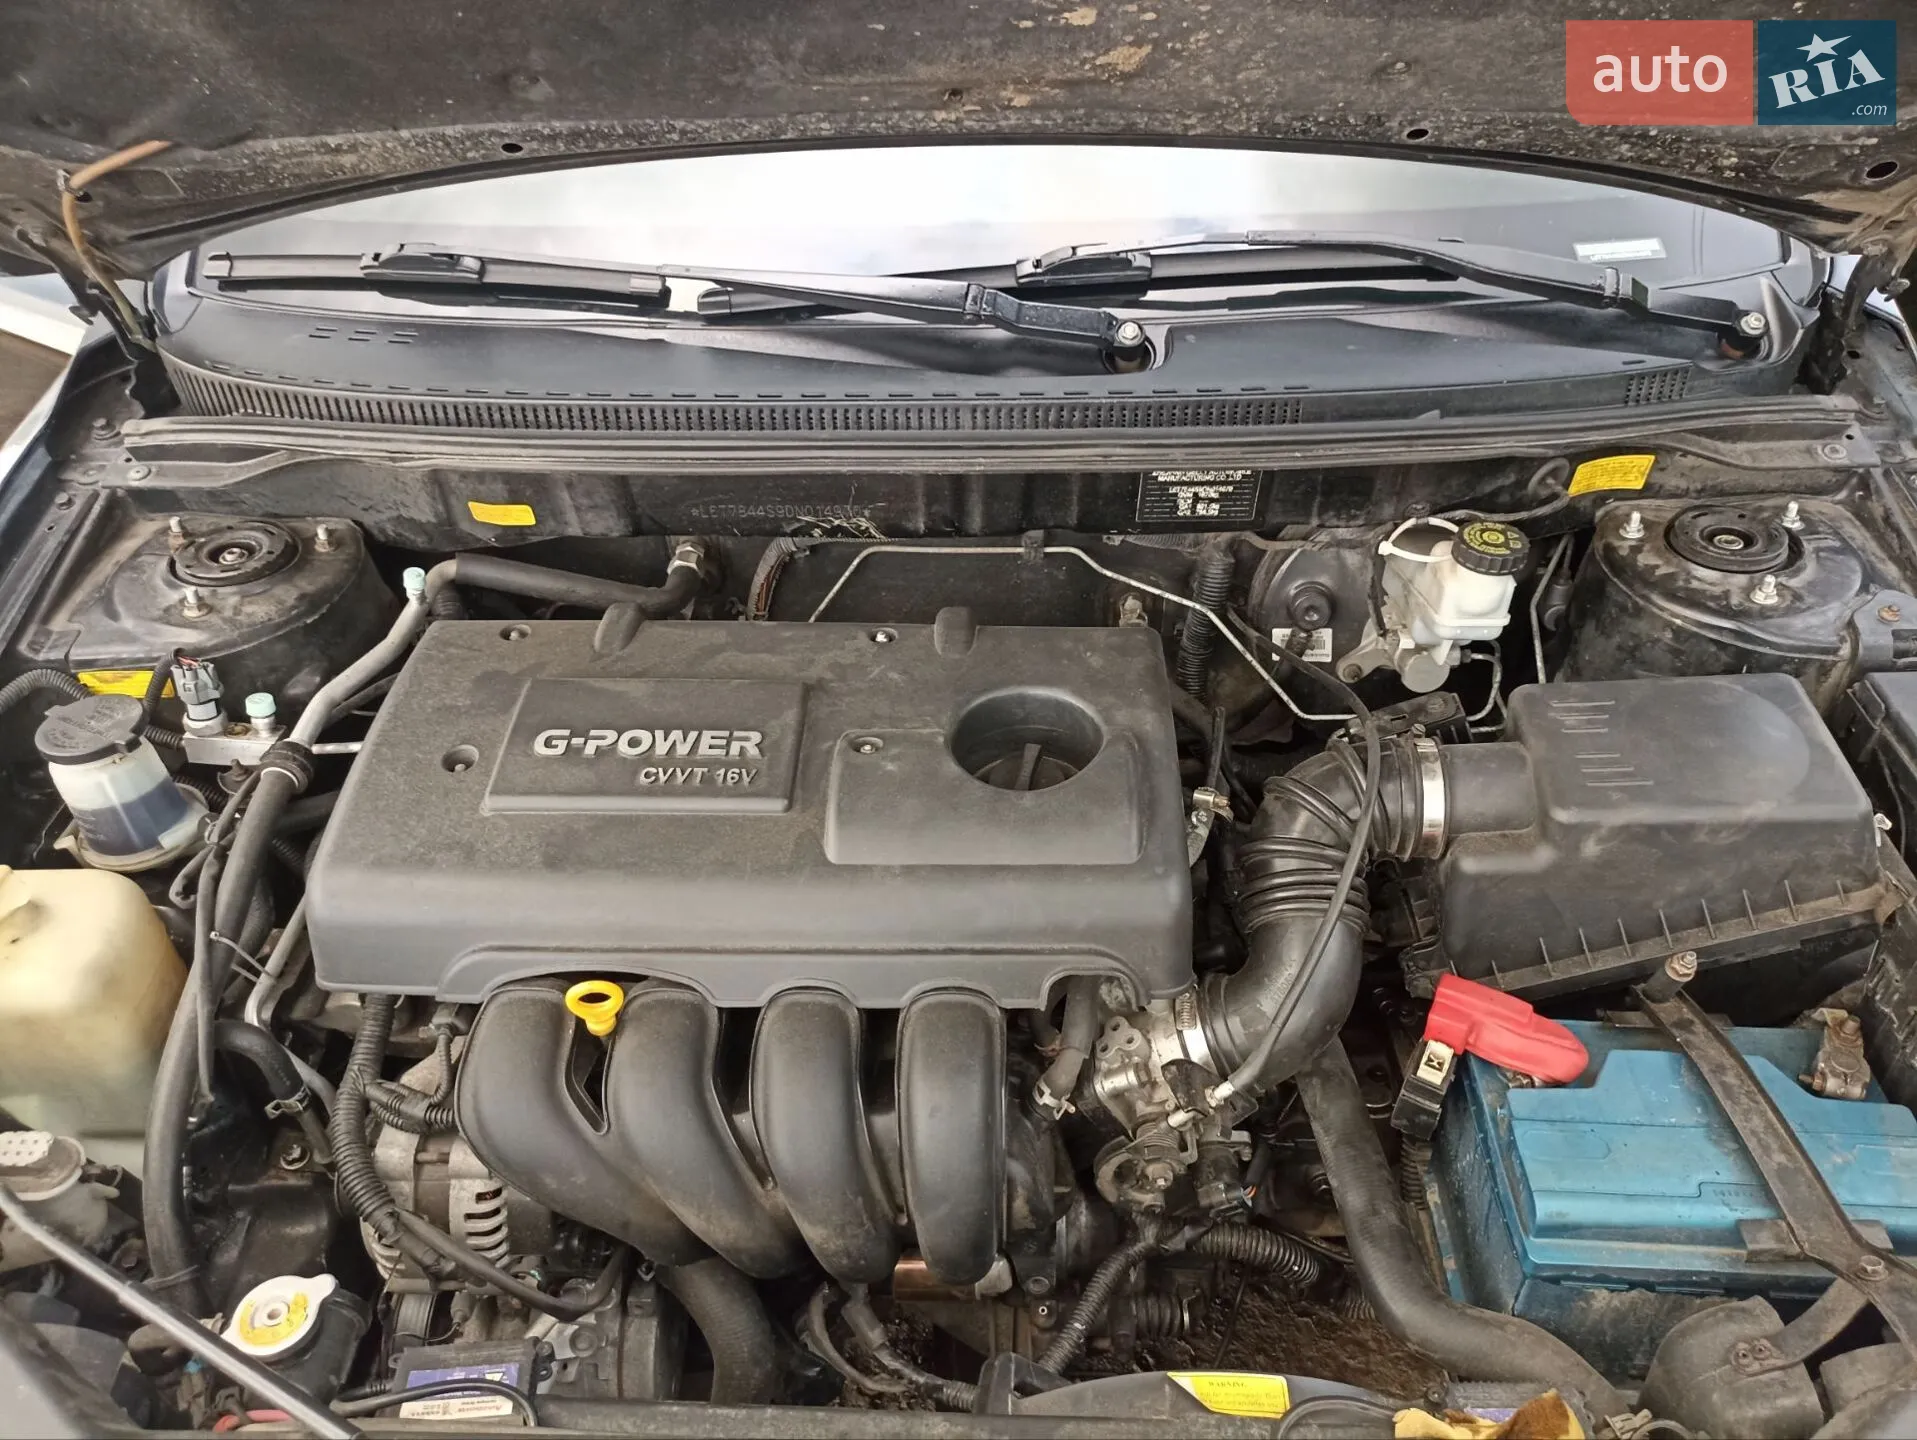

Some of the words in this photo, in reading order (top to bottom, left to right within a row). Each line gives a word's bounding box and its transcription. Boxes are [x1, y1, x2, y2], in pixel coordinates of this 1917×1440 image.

[534, 728, 763, 759] G-POWER
[640, 767, 708, 786] CVVT
[715, 767, 758, 787] 16V
